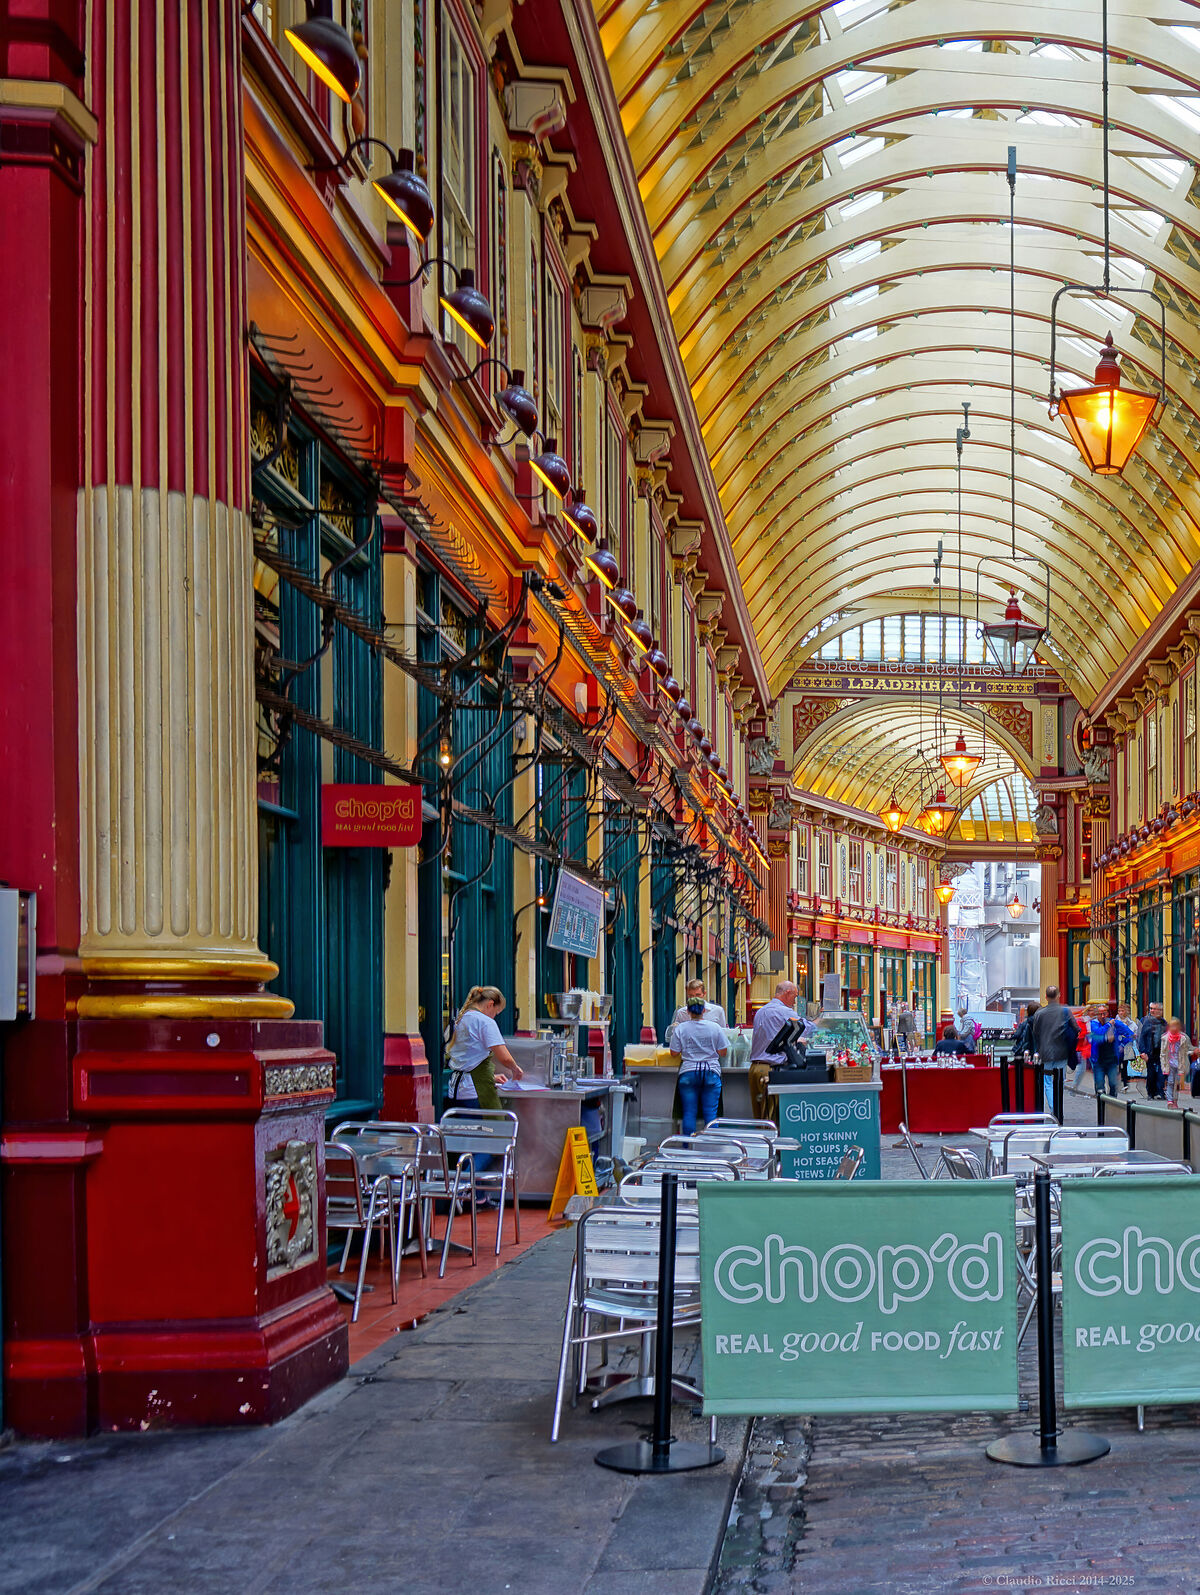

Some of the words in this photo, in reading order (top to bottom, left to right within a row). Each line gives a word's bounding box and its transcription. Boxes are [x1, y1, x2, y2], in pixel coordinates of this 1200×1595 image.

[814, 660, 868, 675] Space
[878, 661, 915, 674] here
[924, 661, 1002, 677] becomes
[847, 678, 981, 692] LEADENHALL
[335, 798, 414, 821] chop'd
[785, 1098, 872, 1124] chop'd
[800, 1133, 820, 1142] HOT
[823, 1131, 858, 1141] SKINNY
[809, 1145, 840, 1154] SOUPS
[843, 1144, 849, 1152] &
[793, 1157, 814, 1167] HOT
[795, 1169, 824, 1179] STEWS
[714, 1232, 1003, 1314] chop'd
[715, 1334, 774, 1354] REAL
[779, 1322, 864, 1361] good
[871, 1331, 941, 1351] FOOD
[939, 1321, 1005, 1359] fast
[1075, 1326, 1131, 1347] REAL
